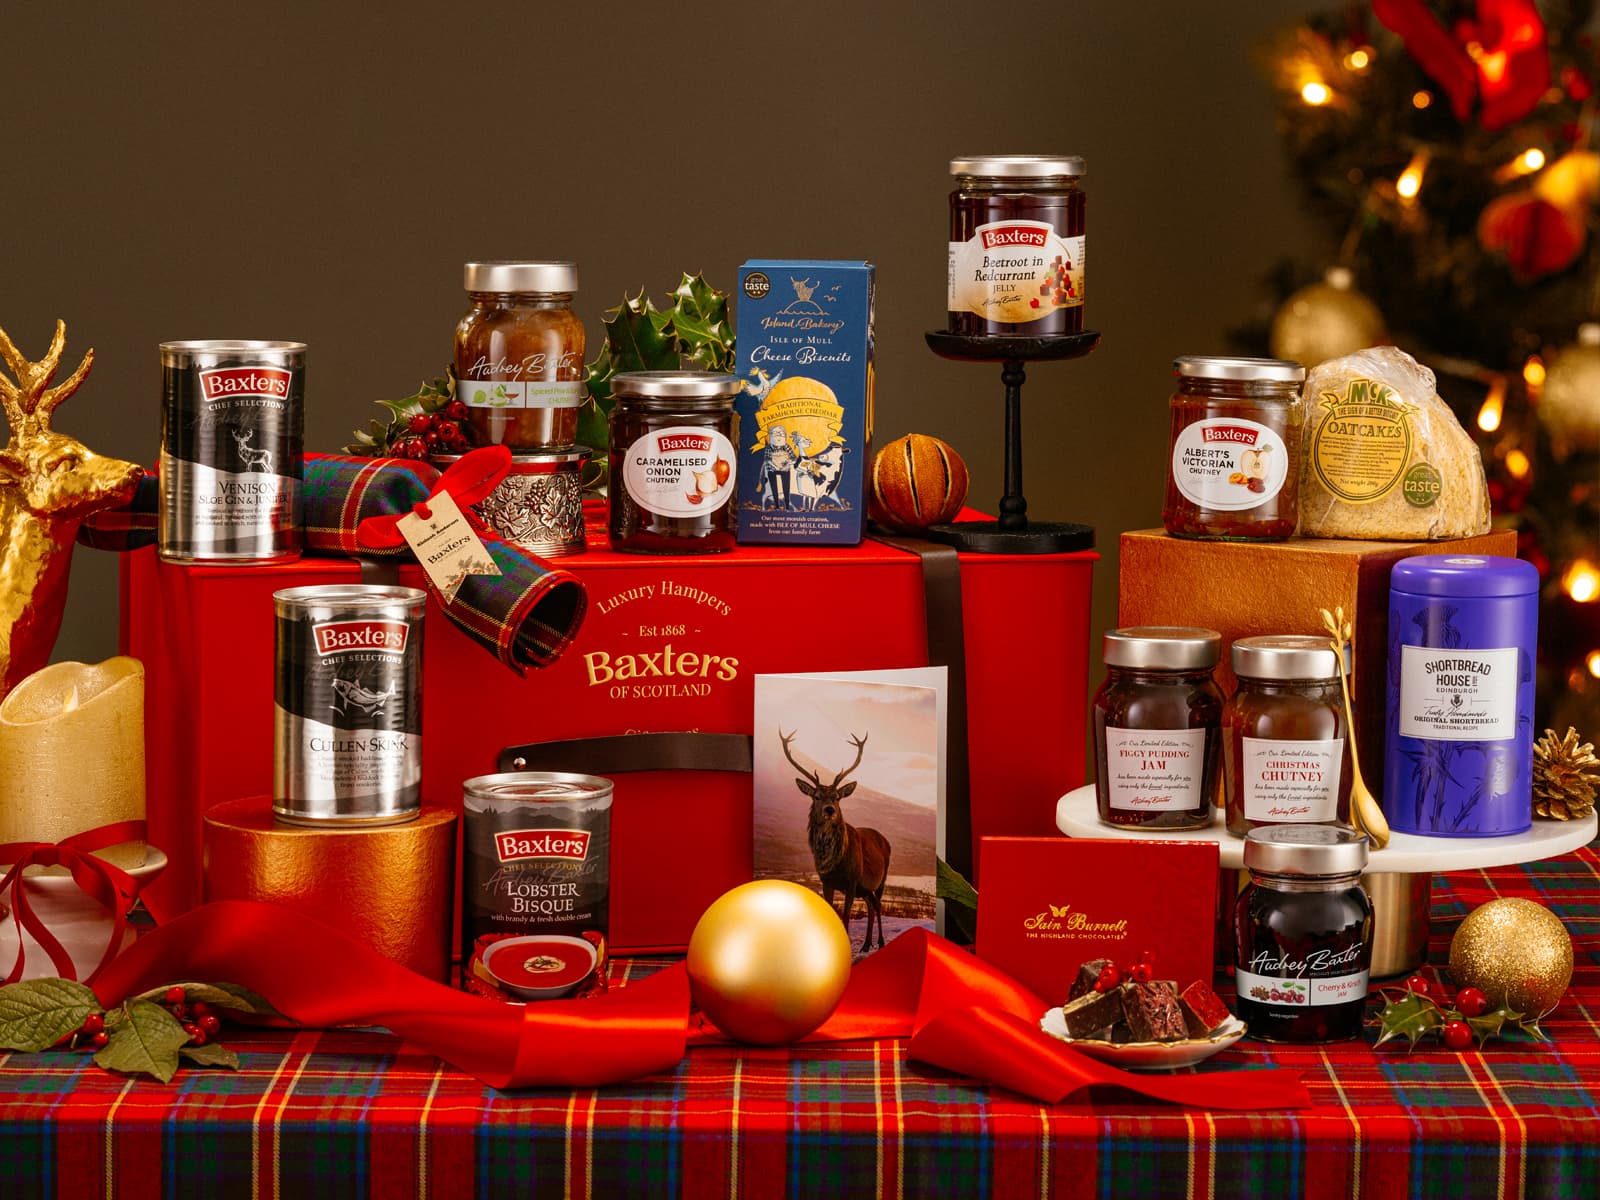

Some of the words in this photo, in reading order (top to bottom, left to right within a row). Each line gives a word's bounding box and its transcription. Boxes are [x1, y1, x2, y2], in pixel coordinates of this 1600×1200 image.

[985, 230, 1044, 247] Baxters
[983, 256, 1028, 268] Beetroot
[1032, 256, 1043, 266] in
[975, 269, 1035, 281] Redcurrant
[745, 282, 769, 291] taste
[993, 284, 1017, 293] JELLY
[761, 317, 795, 330] Island
[797, 317, 845, 335] Bakery
[751, 345, 792, 363] Cheese
[795, 346, 851, 364] Biscuits
[467, 355, 523, 382] Audrey
[207, 373, 285, 394] Baxters
[208, 401, 232, 411] CHEF
[235, 400, 285, 410] SELECTIONS
[776, 401, 821, 411] TRADITIONAL
[763, 408, 804, 422] FARMHOUSE
[804, 408, 838, 419] CHEDDAR
[1328, 421, 1401, 438] OATCAKES
[1204, 429, 1255, 444] Baxters
[661, 437, 709, 450] Baxters
[1185, 448, 1229, 459] ALBERT'S
[636, 458, 707, 466] CARAMELISED
[1182, 457, 1234, 469] VICTORIAN
[646, 468, 681, 476] ONION
[1189, 467, 1221, 476] CHUTNEY
[219, 481, 276, 495] VENISON
[1404, 480, 1440, 493] taste
[198, 495, 223, 505] SLOE
[225, 495, 244, 505] GIN
[427, 535, 471, 564] Baxters
[596, 583, 656, 615] Luxury
[660, 580, 732, 616] Hampers
[321, 626, 402, 648] Baxters
[639, 625, 657, 637] Est
[661, 624, 686, 636] 1868
[322, 655, 344, 666] CHEF
[348, 654, 402, 665] SELECTIONS
[583, 643, 739, 686] Baxters
[1425, 659, 1491, 675] SHORTBREAD
[1436, 674, 1470, 686] HOUSE
[610, 686, 629, 699] OF
[632, 683, 711, 699] SCOTLAND
[1414, 715, 1448, 724] ORIGINAL
[310, 737, 366, 752] CULLEN
[369, 737, 409, 752] SKINK
[1120, 749, 1145, 758] FIGGY
[1148, 750, 1190, 758] PUDDING
[1141, 760, 1166, 770] JAM
[1266, 761, 1320, 769] CHRISTMAS
[1261, 771, 1324, 782] CHUTNEY
[502, 835, 583, 856] Baxters
[503, 863, 524, 873] CHEF
[507, 881, 581, 897] LOBSTER
[511, 898, 574, 914] BISQUE
[491, 913, 504, 921] with
[505, 914, 528, 924] brandy
[554, 913, 575, 922] double
[1024, 912, 1062, 930] Iain
[1067, 912, 1127, 932] Burnett
[1248, 950, 1307, 981] Audrey
[1306, 942, 1363, 971] Baxter
[1318, 983, 1340, 991] Cherry
